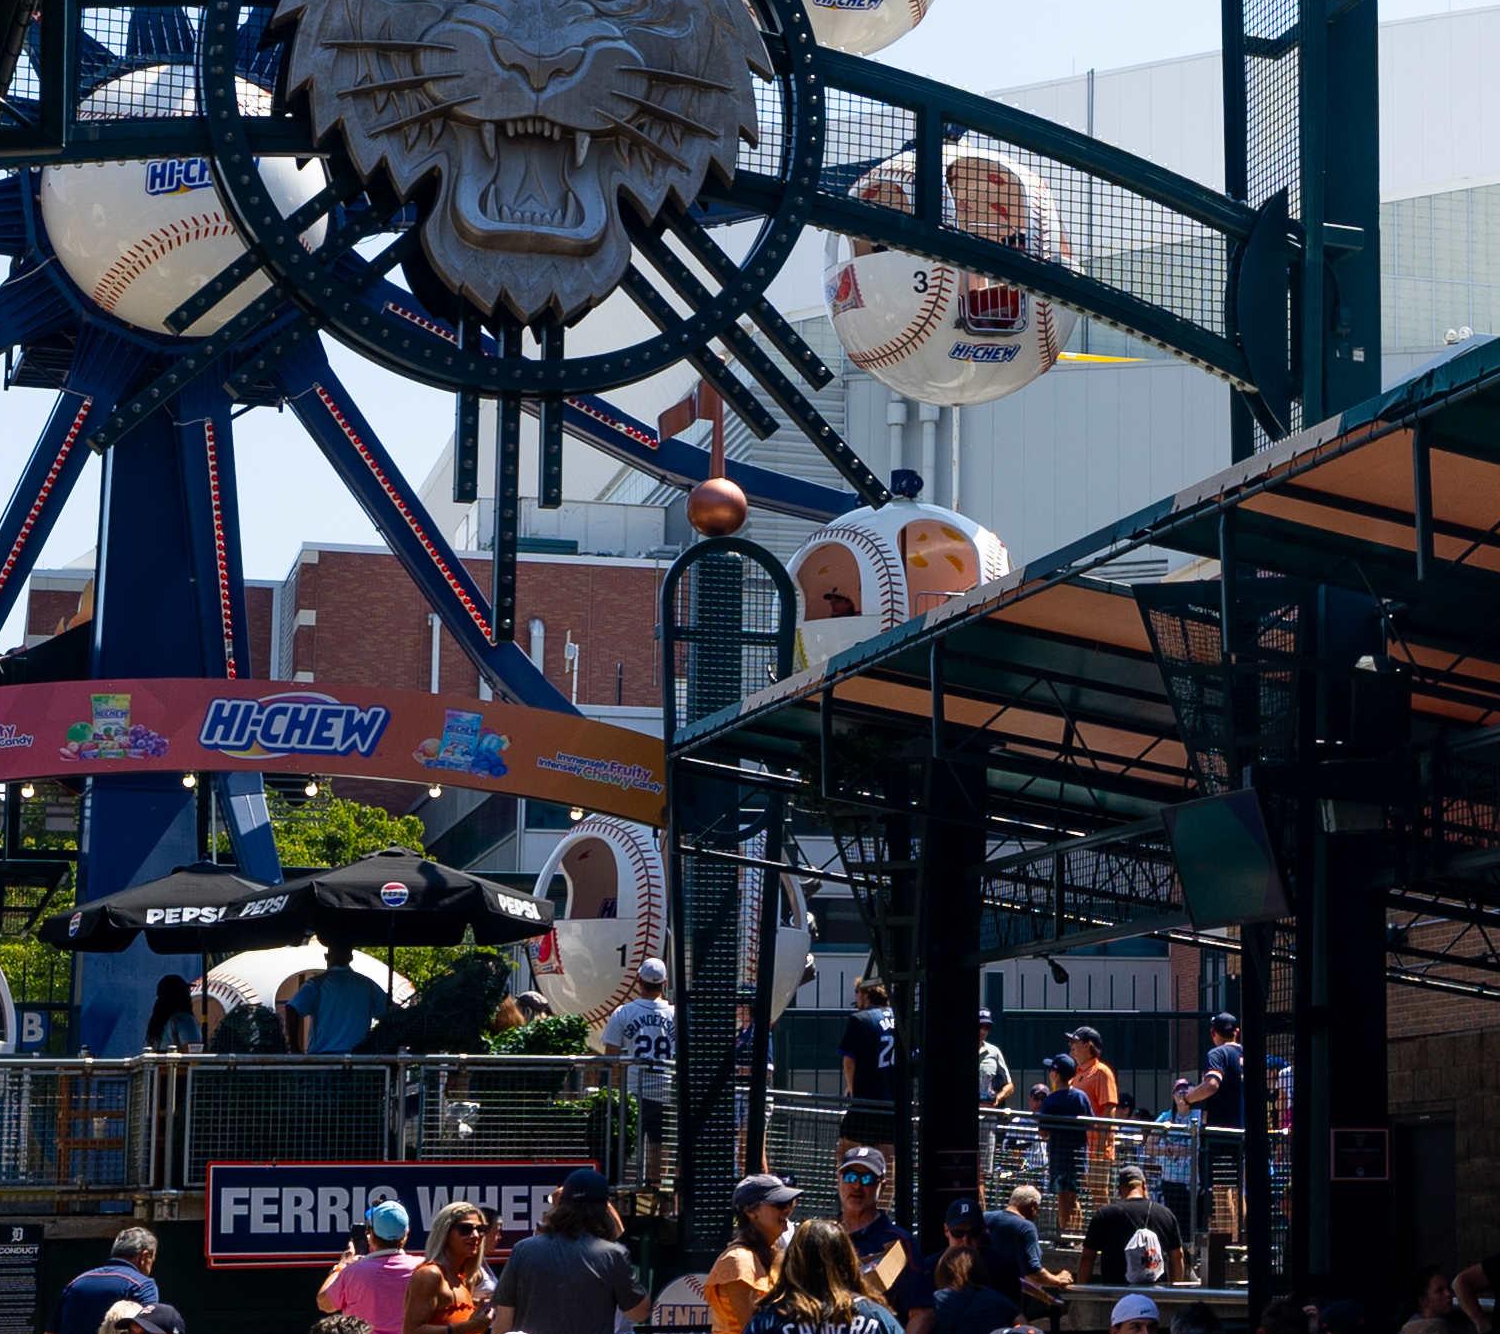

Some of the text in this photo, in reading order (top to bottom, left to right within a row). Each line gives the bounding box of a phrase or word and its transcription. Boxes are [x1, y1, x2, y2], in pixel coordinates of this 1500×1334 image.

[913, 270, 929, 294] 3
[948, 341, 1021, 363] HI-CHEW
[198, 699, 391, 758] HI-CHEW
[537, 758, 665, 795] Intensely Chewy Candy
[557, 751, 652, 782] Immensely Fruity
[146, 906, 227, 925] PEPSI
[240, 894, 289, 917] PEPSI
[497, 893, 541, 920] PEPSI
[615, 943, 628, 967] 1
[22, 1012, 45, 1043] B
[634, 1034, 673, 1063] 28
[878, 1034, 896, 1068] 2
